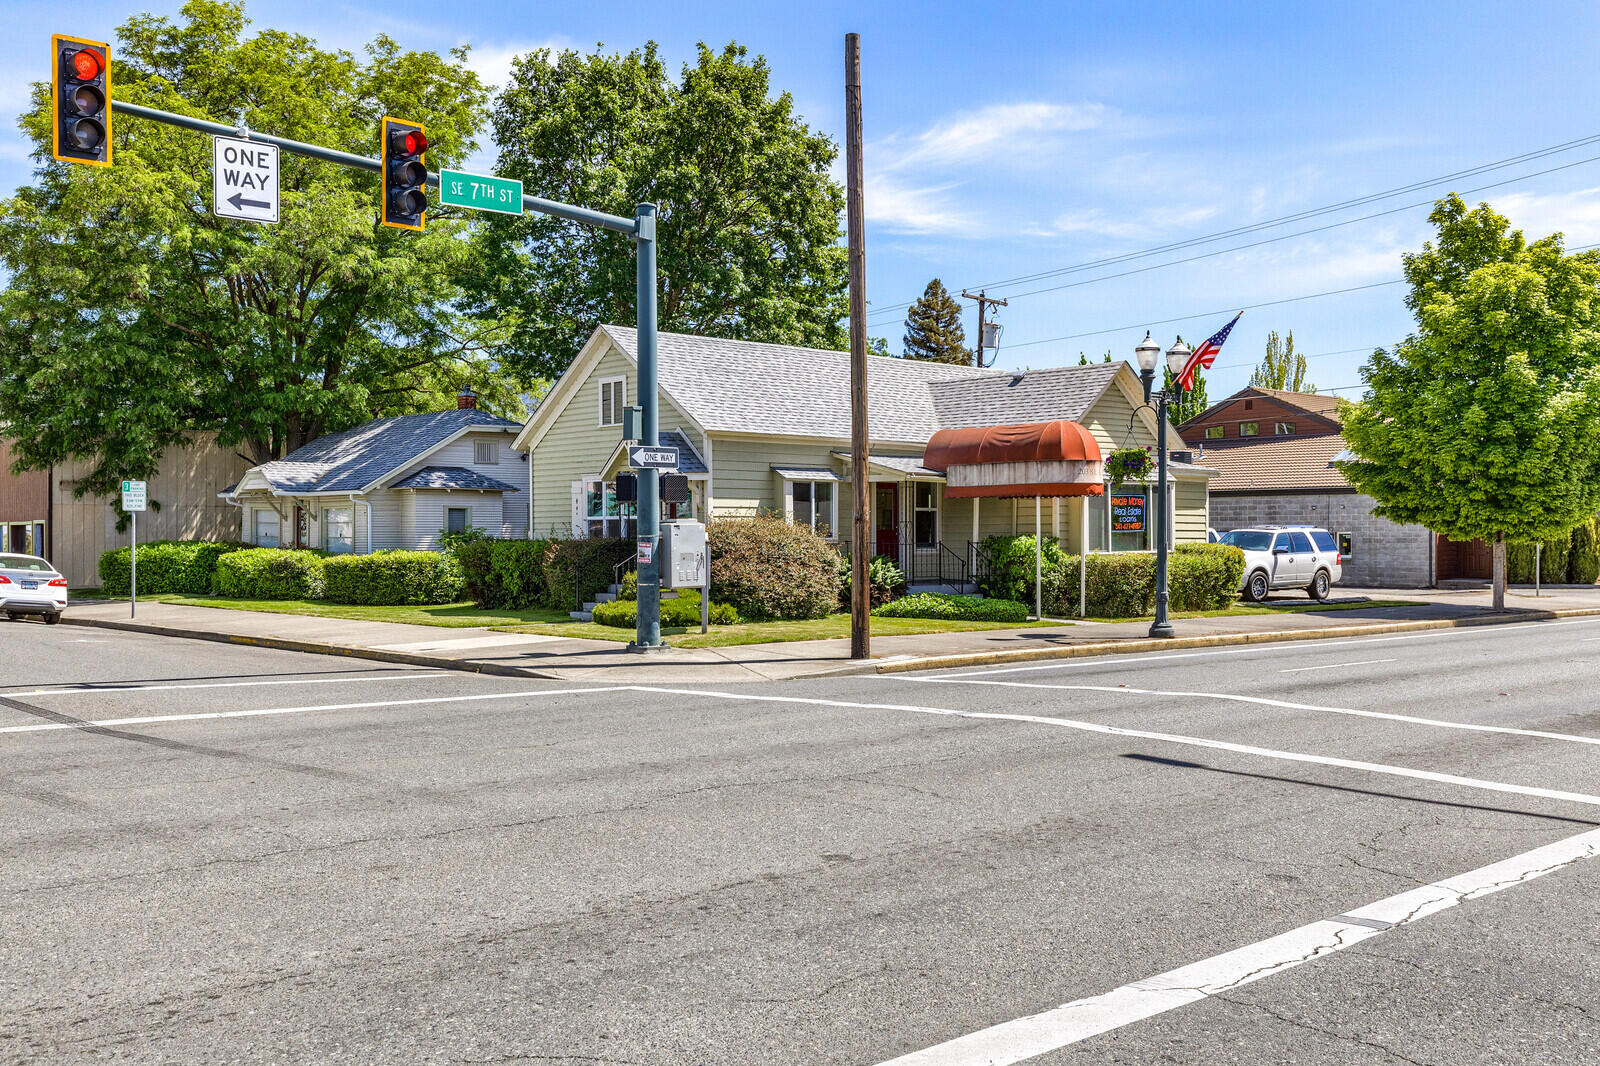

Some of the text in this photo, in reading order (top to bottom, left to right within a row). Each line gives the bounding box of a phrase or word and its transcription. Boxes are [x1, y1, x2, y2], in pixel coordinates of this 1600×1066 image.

[224, 147, 270, 169] ONE
[223, 168, 270, 190] WAY
[451, 181, 513, 203] SE 7TH ST
[644, 452, 674, 462] ONE WAY
[1128, 497, 1144, 507] Money
[1114, 507, 1142, 515] Real Estate
